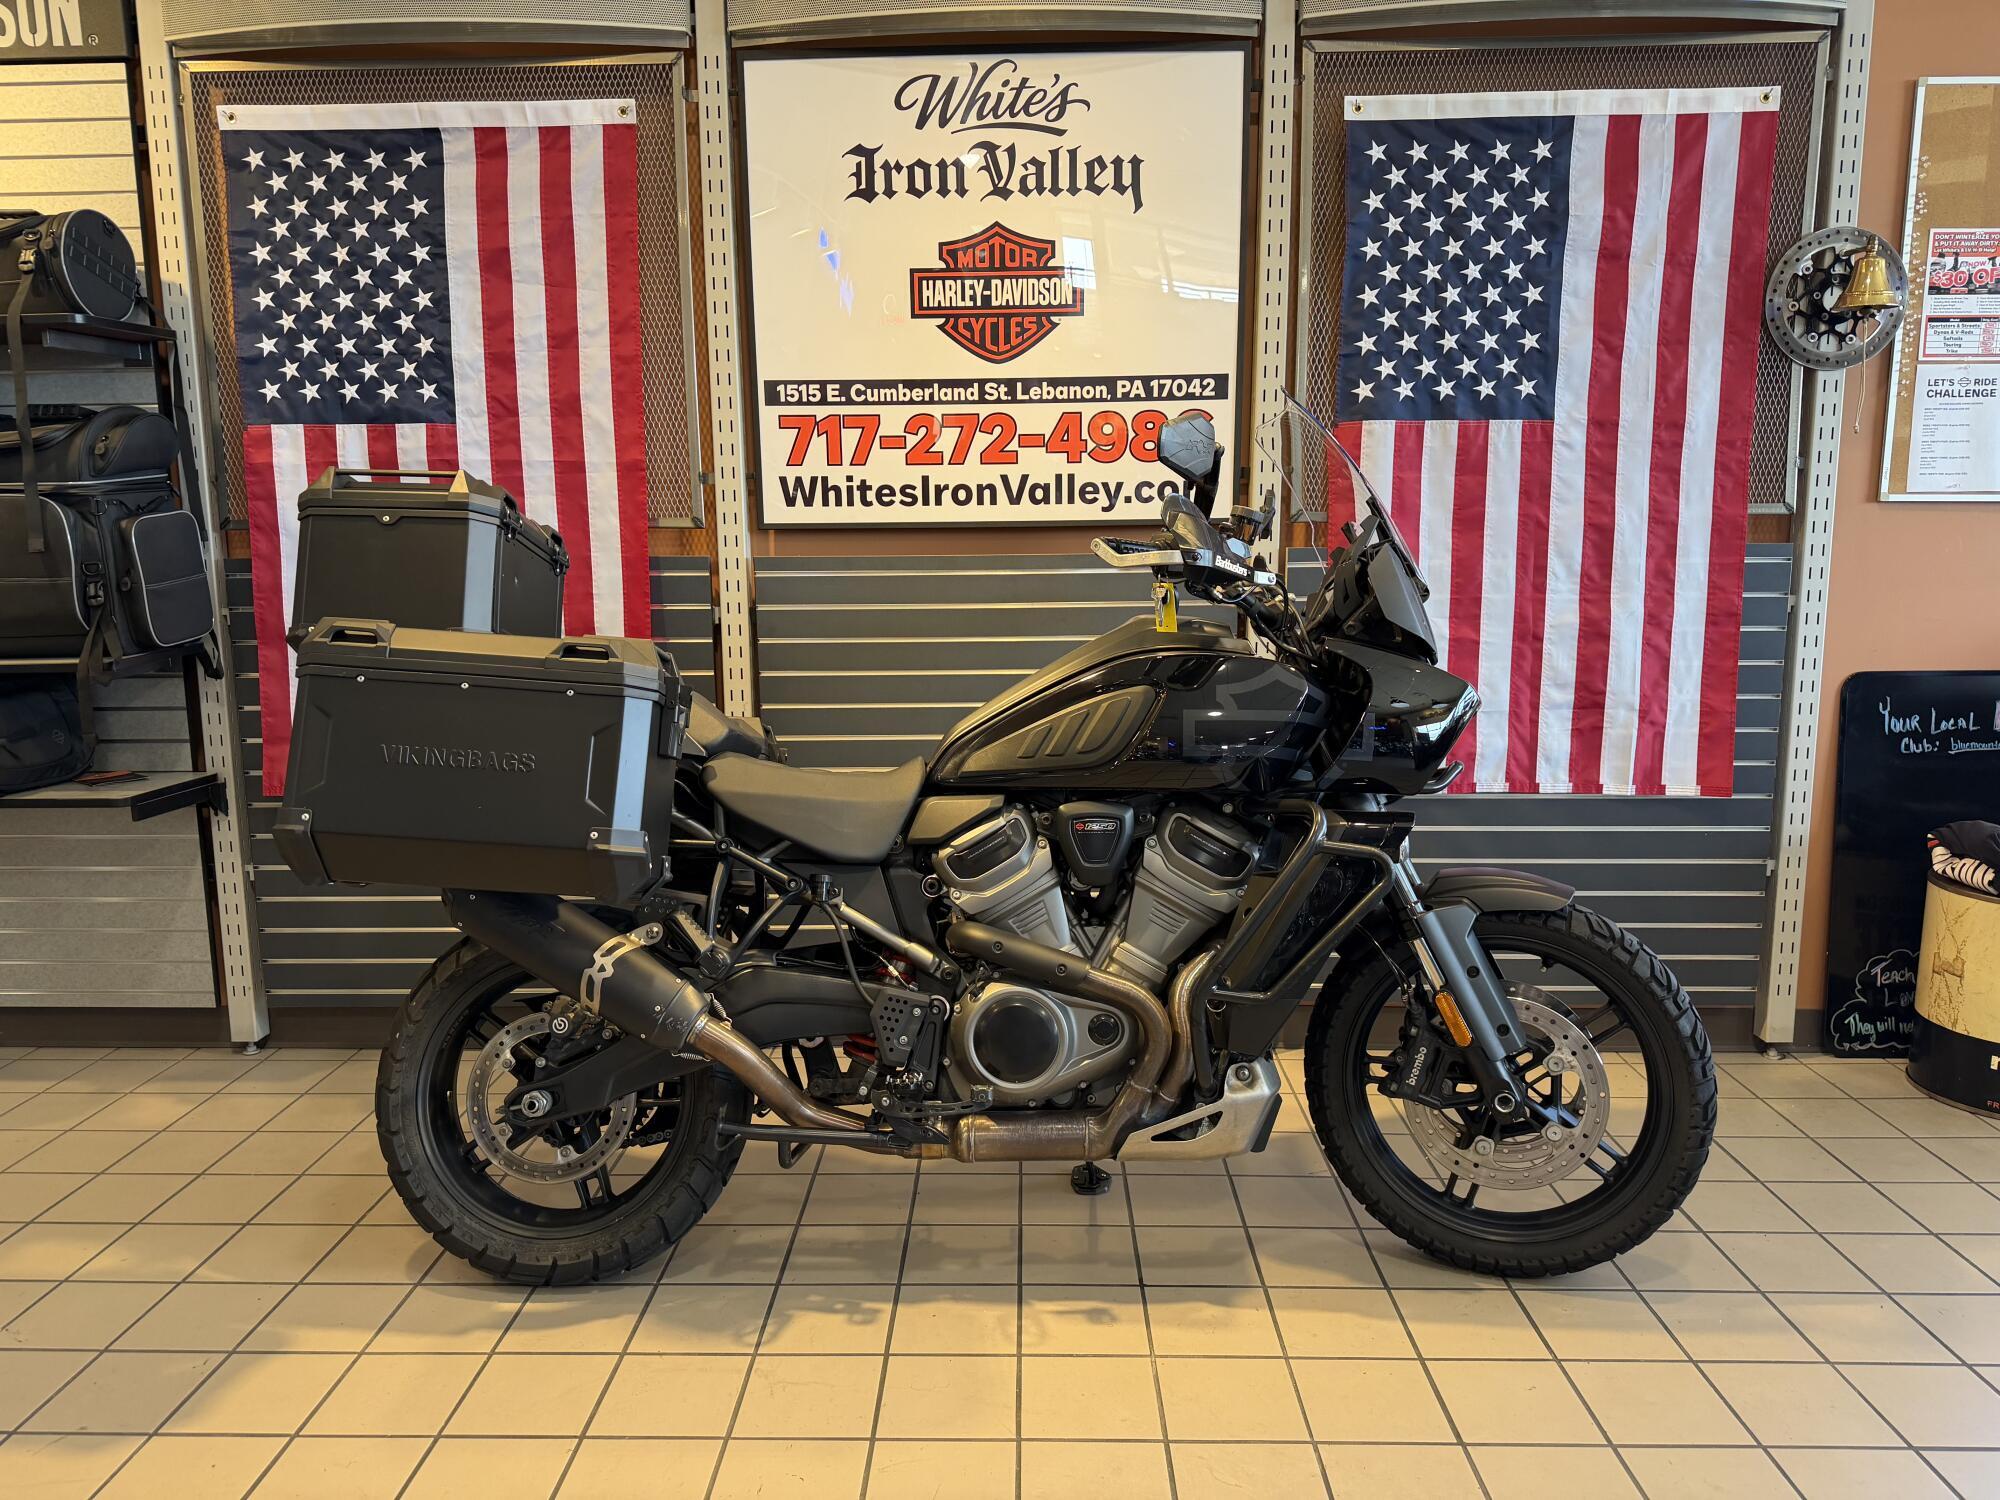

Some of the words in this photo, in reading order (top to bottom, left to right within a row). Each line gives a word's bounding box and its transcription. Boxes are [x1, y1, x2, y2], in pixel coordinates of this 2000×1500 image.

[893, 58, 1091, 131] White's
[841, 143, 970, 204] Iron
[967, 140, 1145, 214] Valley
[957, 236, 1039, 269] MOTOR
[921, 277, 1074, 308] HARLEY-DAVIDSON
[1933, 270, 1969, 288] $30
[957, 316, 1039, 352] CYCLES
[776, 384, 822, 403] 1515
[826, 384, 846, 402] E.
[850, 382, 979, 402] Cumberland
[984, 382, 1012, 401] St.
[1016, 381, 1111, 401] Lebanon,
[1116, 379, 1147, 398] PA
[1149, 377, 1216, 398] 17042
[1926, 388, 1998, 399] CHALLENGE
[1927, 378, 1955, 388] LET'S
[1973, 378, 1998, 387] RIDE
[778, 408, 1214, 467] 717-272-498
[380, 743, 536, 773] VIKINGBAGS
[1405, 1046, 1427, 1086] brembo
